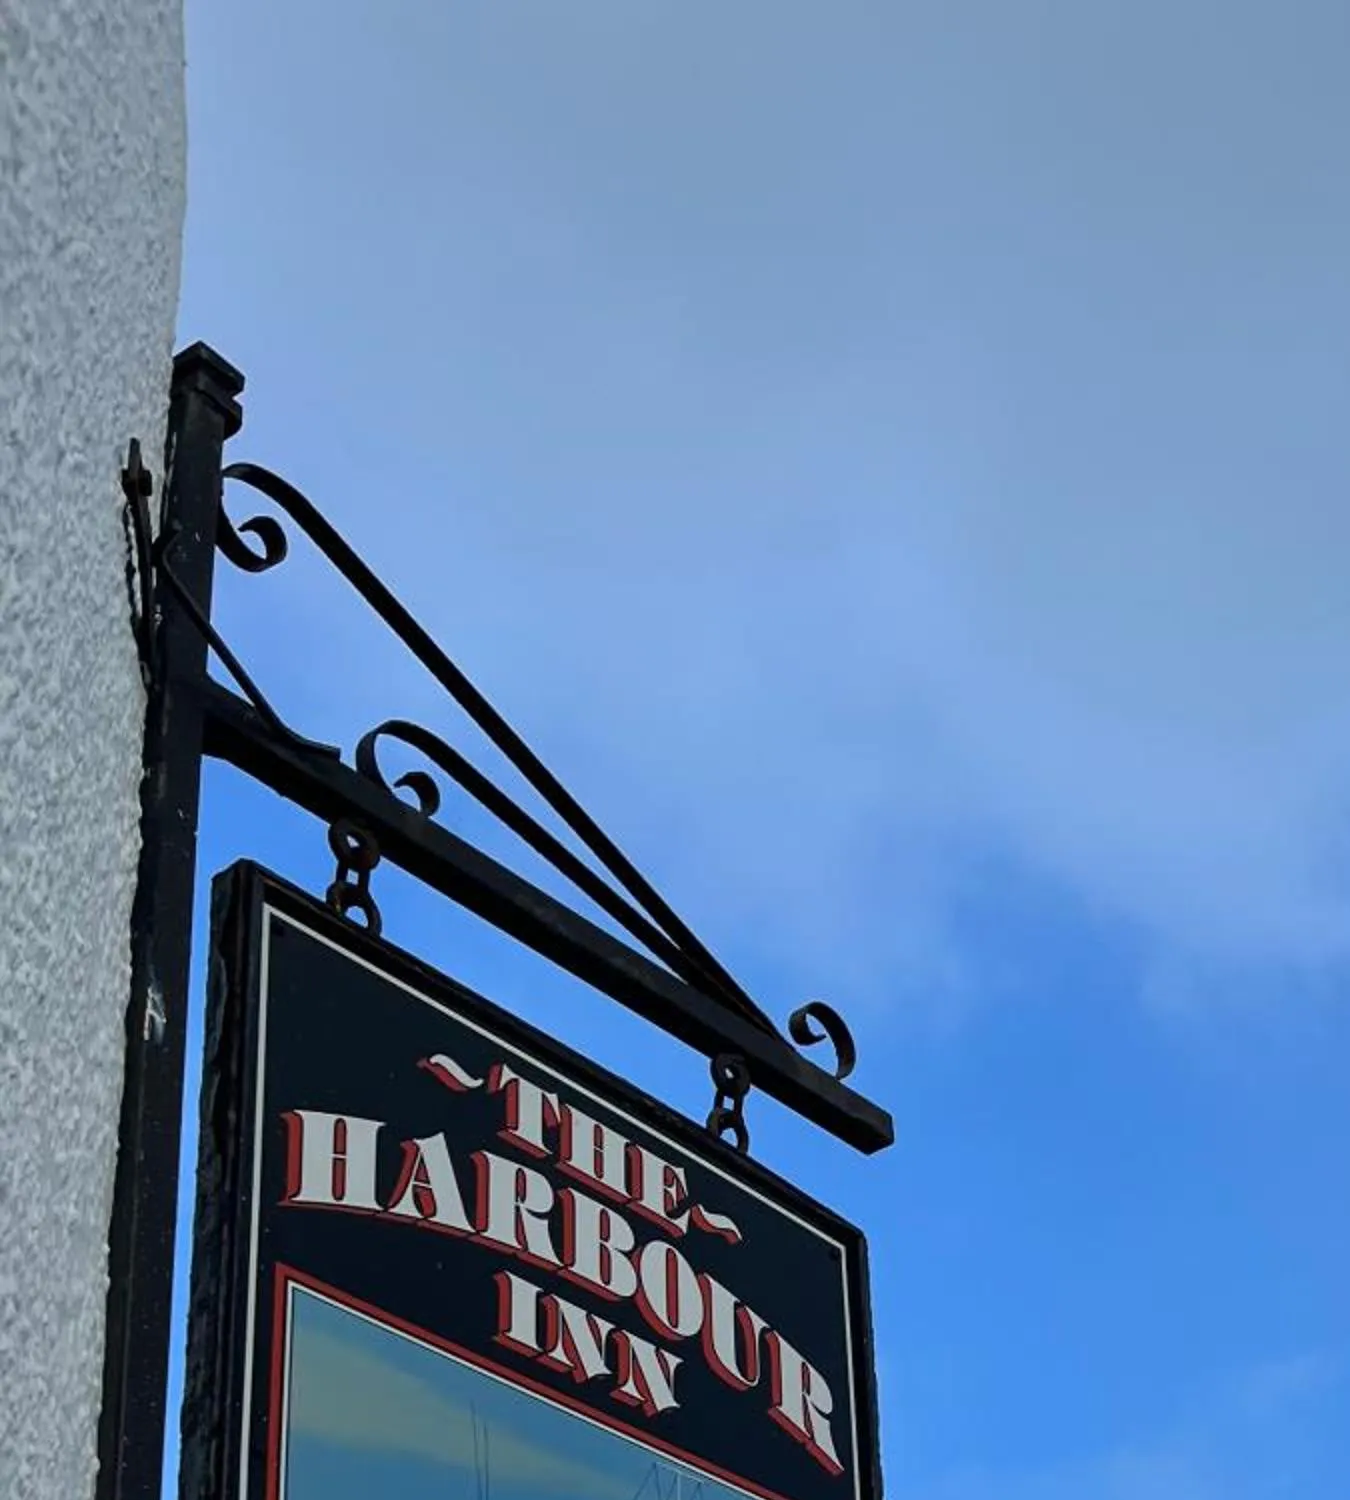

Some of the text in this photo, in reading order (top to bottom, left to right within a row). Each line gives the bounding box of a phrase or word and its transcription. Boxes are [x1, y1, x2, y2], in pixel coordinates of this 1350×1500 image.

[490, 1061, 690, 1237] THE
[279, 1108, 844, 1475] HARBOUR
[495, 1269, 684, 1417] INN
